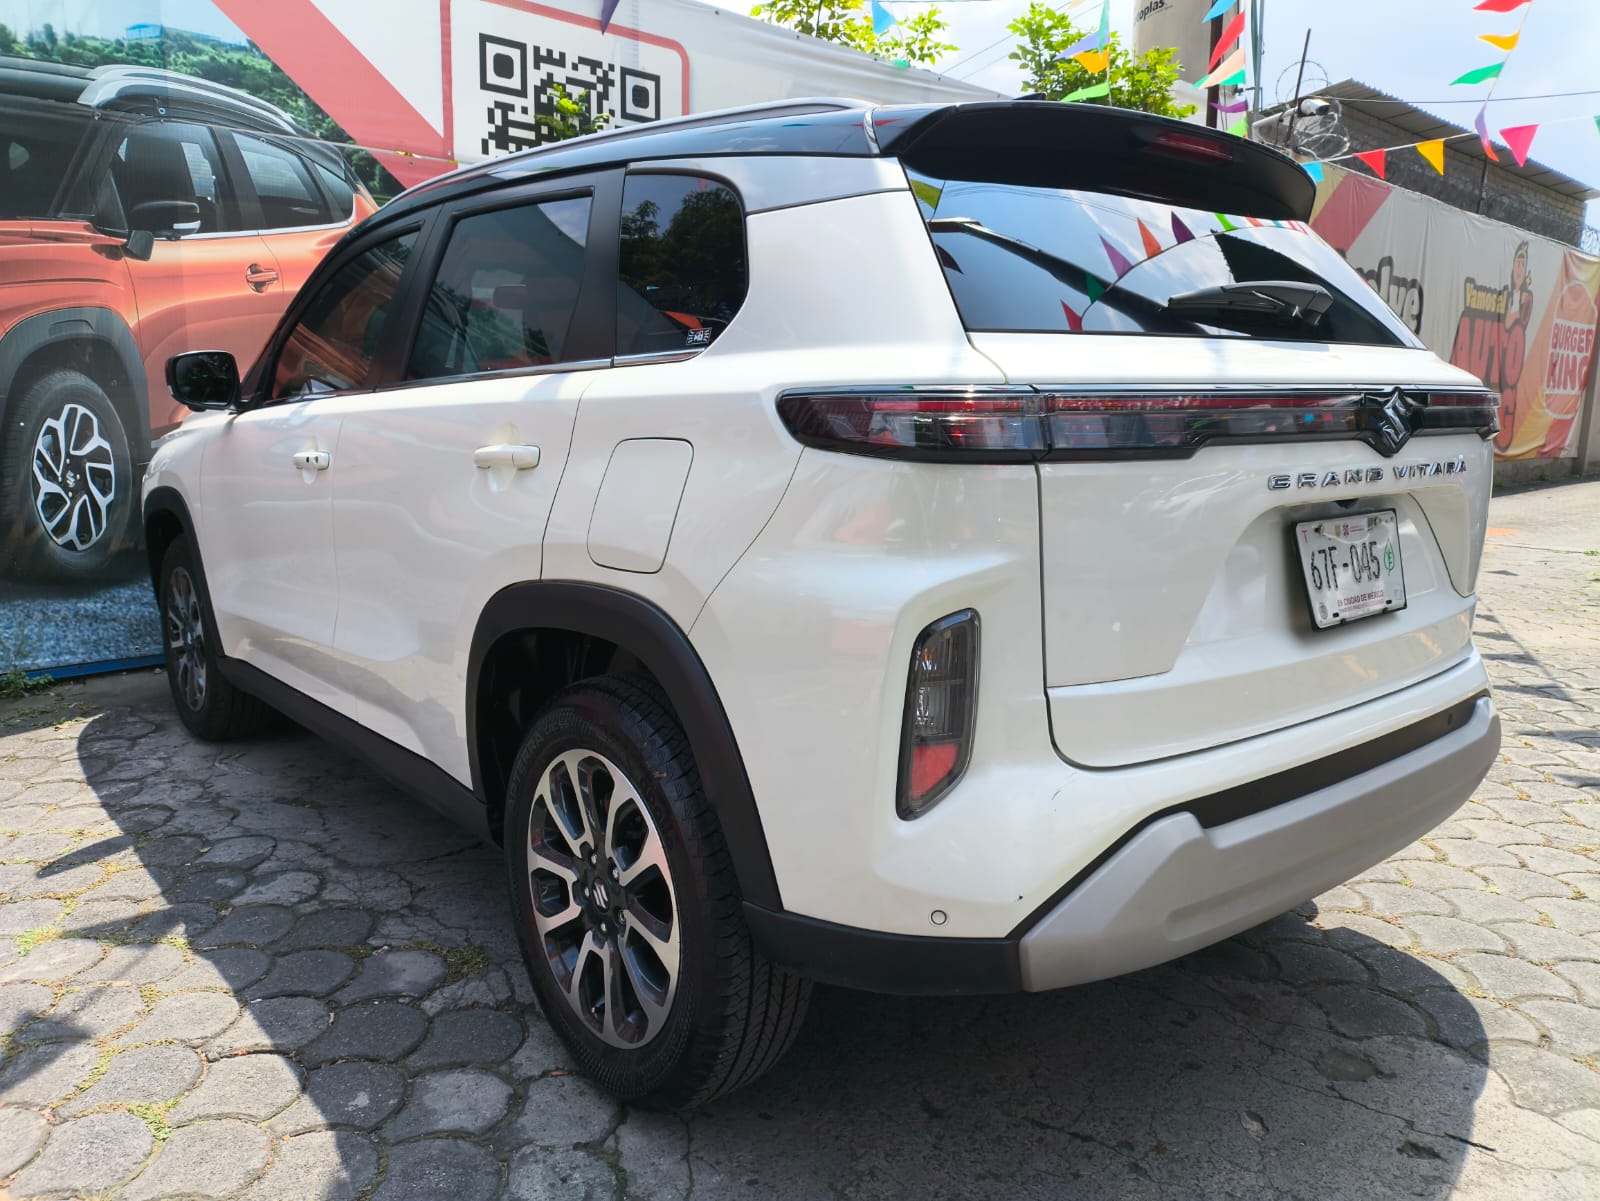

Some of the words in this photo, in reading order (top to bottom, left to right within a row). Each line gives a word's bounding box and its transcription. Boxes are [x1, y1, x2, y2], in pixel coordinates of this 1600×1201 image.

[1551, 322, 1593, 353] BURGER
[1268, 467, 1384, 489] GRAND
[1393, 458, 1467, 479] VITARA
[1310, 541, 1381, 591] 67F-045
